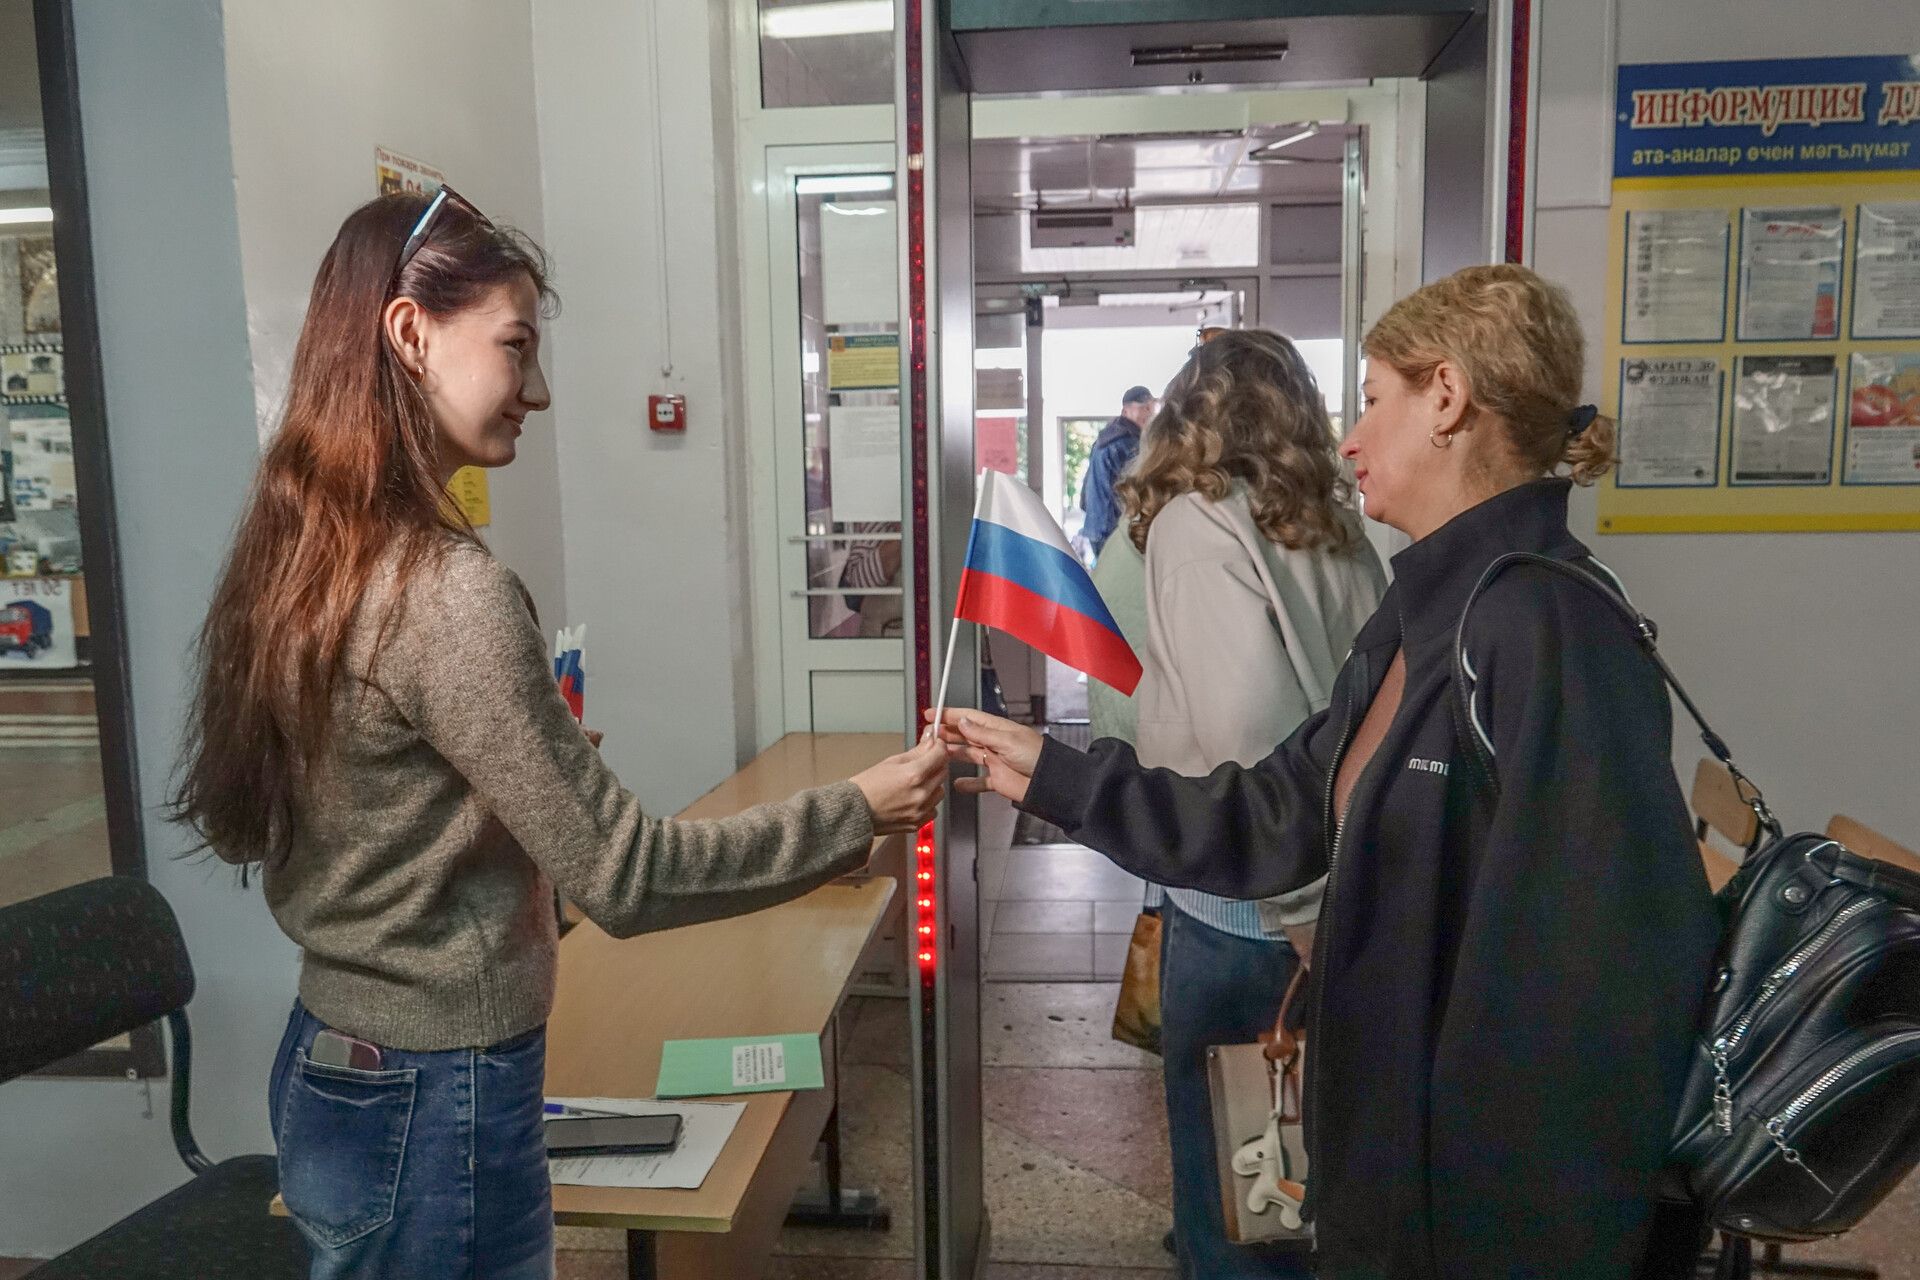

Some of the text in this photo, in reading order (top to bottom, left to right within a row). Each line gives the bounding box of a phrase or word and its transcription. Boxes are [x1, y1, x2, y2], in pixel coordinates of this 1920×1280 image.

[1632, 84, 1865, 135] ИНФОРМАЦИЯ
[1632, 147, 1740, 166] ата-аналар
[1747, 145, 1794, 161] өчен
